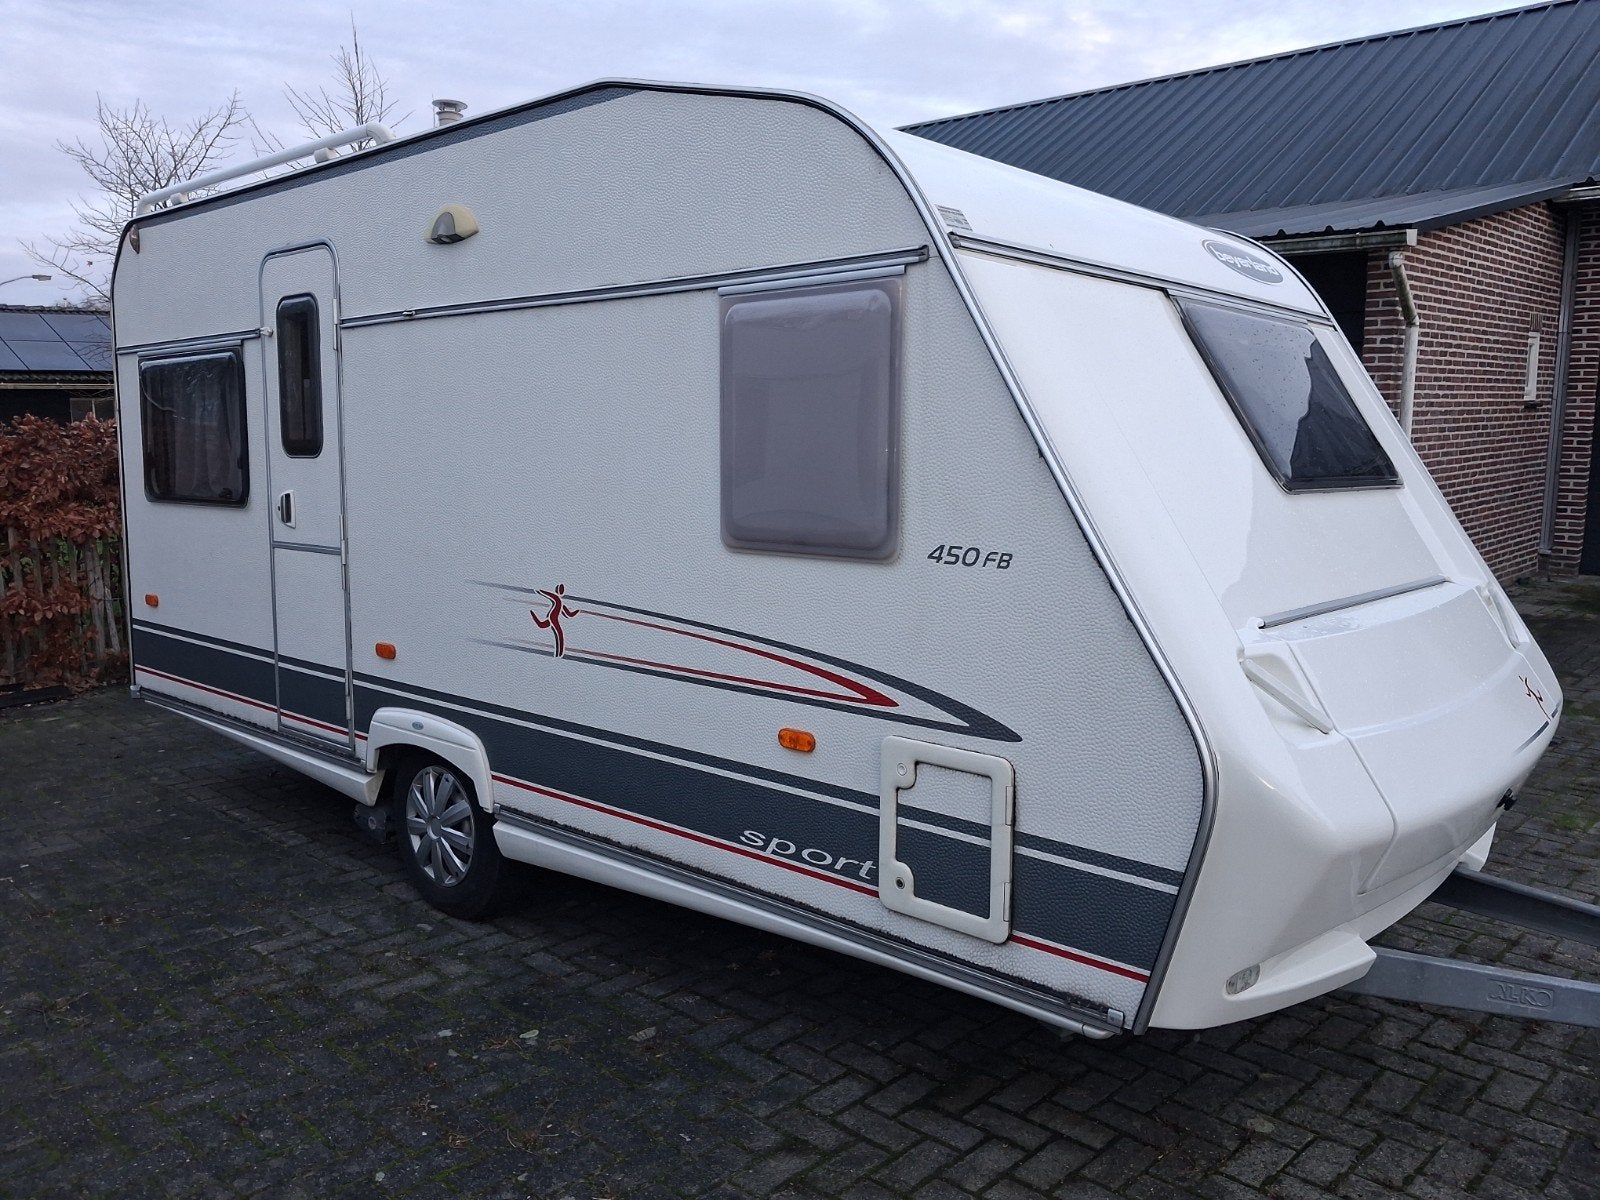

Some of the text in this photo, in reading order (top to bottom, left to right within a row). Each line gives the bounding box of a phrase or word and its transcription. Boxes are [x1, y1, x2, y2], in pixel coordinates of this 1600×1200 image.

[1209, 245, 1280, 276] beyerland
[926, 544, 1014, 570] 450 FB
[739, 830, 877, 880] sport
